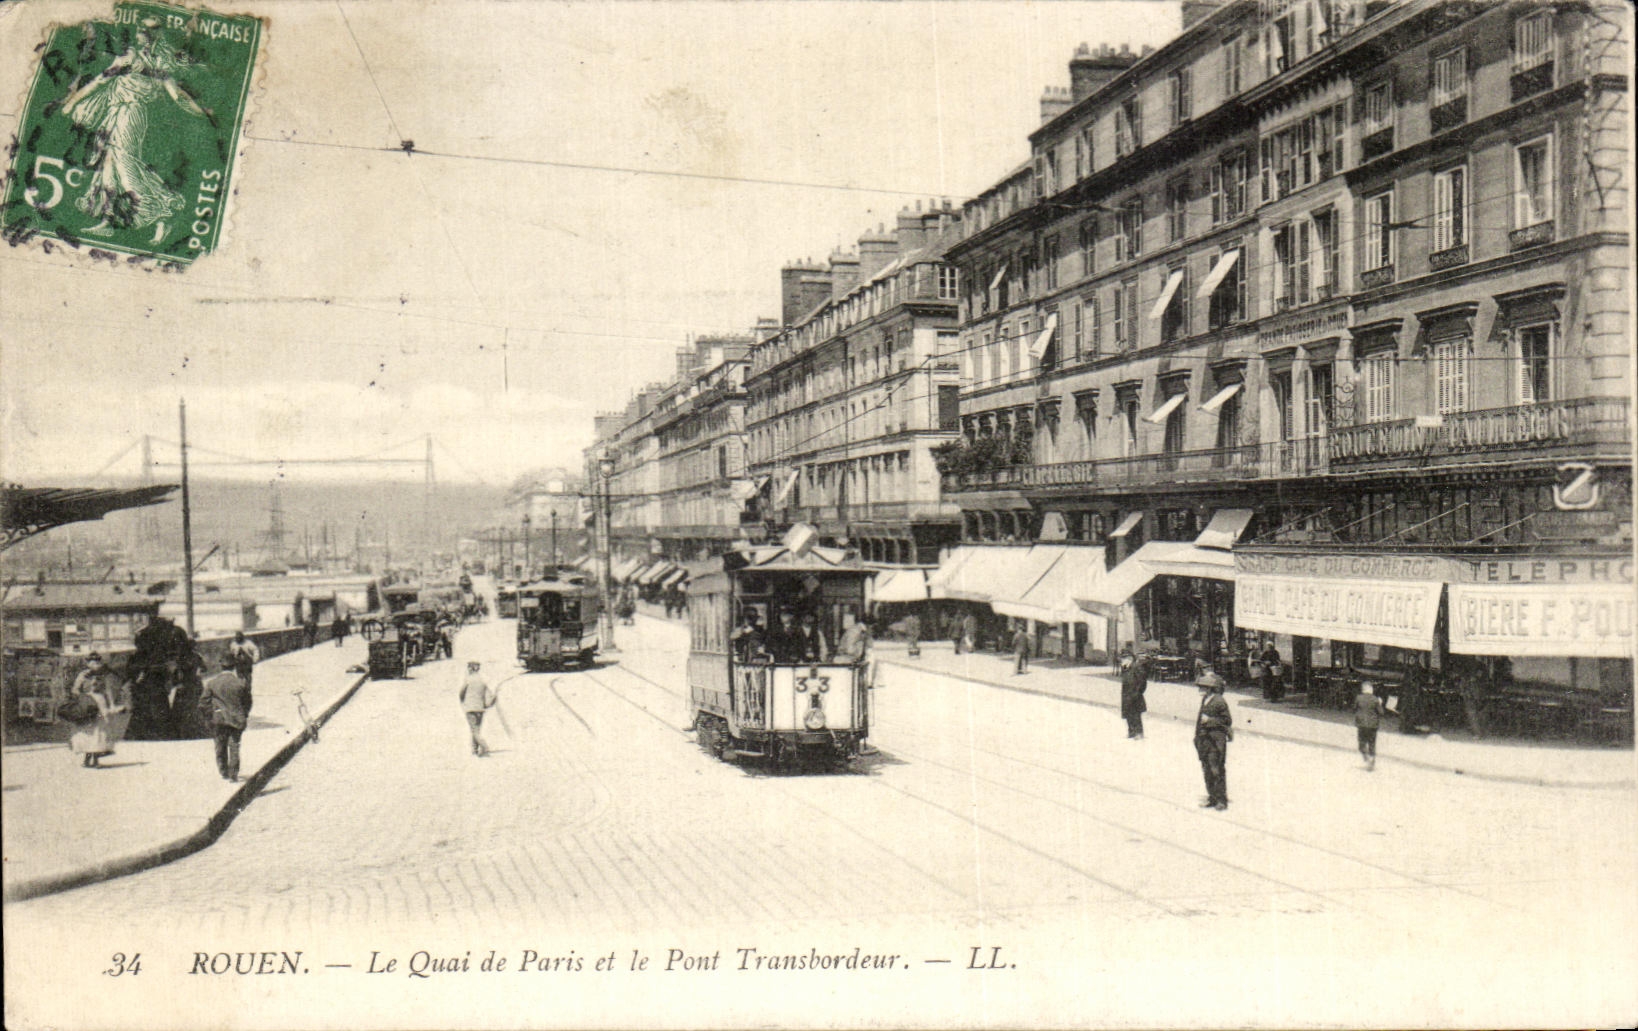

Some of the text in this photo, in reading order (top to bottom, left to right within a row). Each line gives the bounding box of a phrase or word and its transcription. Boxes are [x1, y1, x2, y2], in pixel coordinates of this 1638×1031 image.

[166, 14, 250, 43] FRNÇAISE
[188, 169, 222, 251] POSTES
[1324, 558, 1344, 574] DU
[1350, 558, 1434, 576] COMMERCE
[1320, 589, 1341, 623] DU
[1346, 591, 1423, 630] COMMERCE
